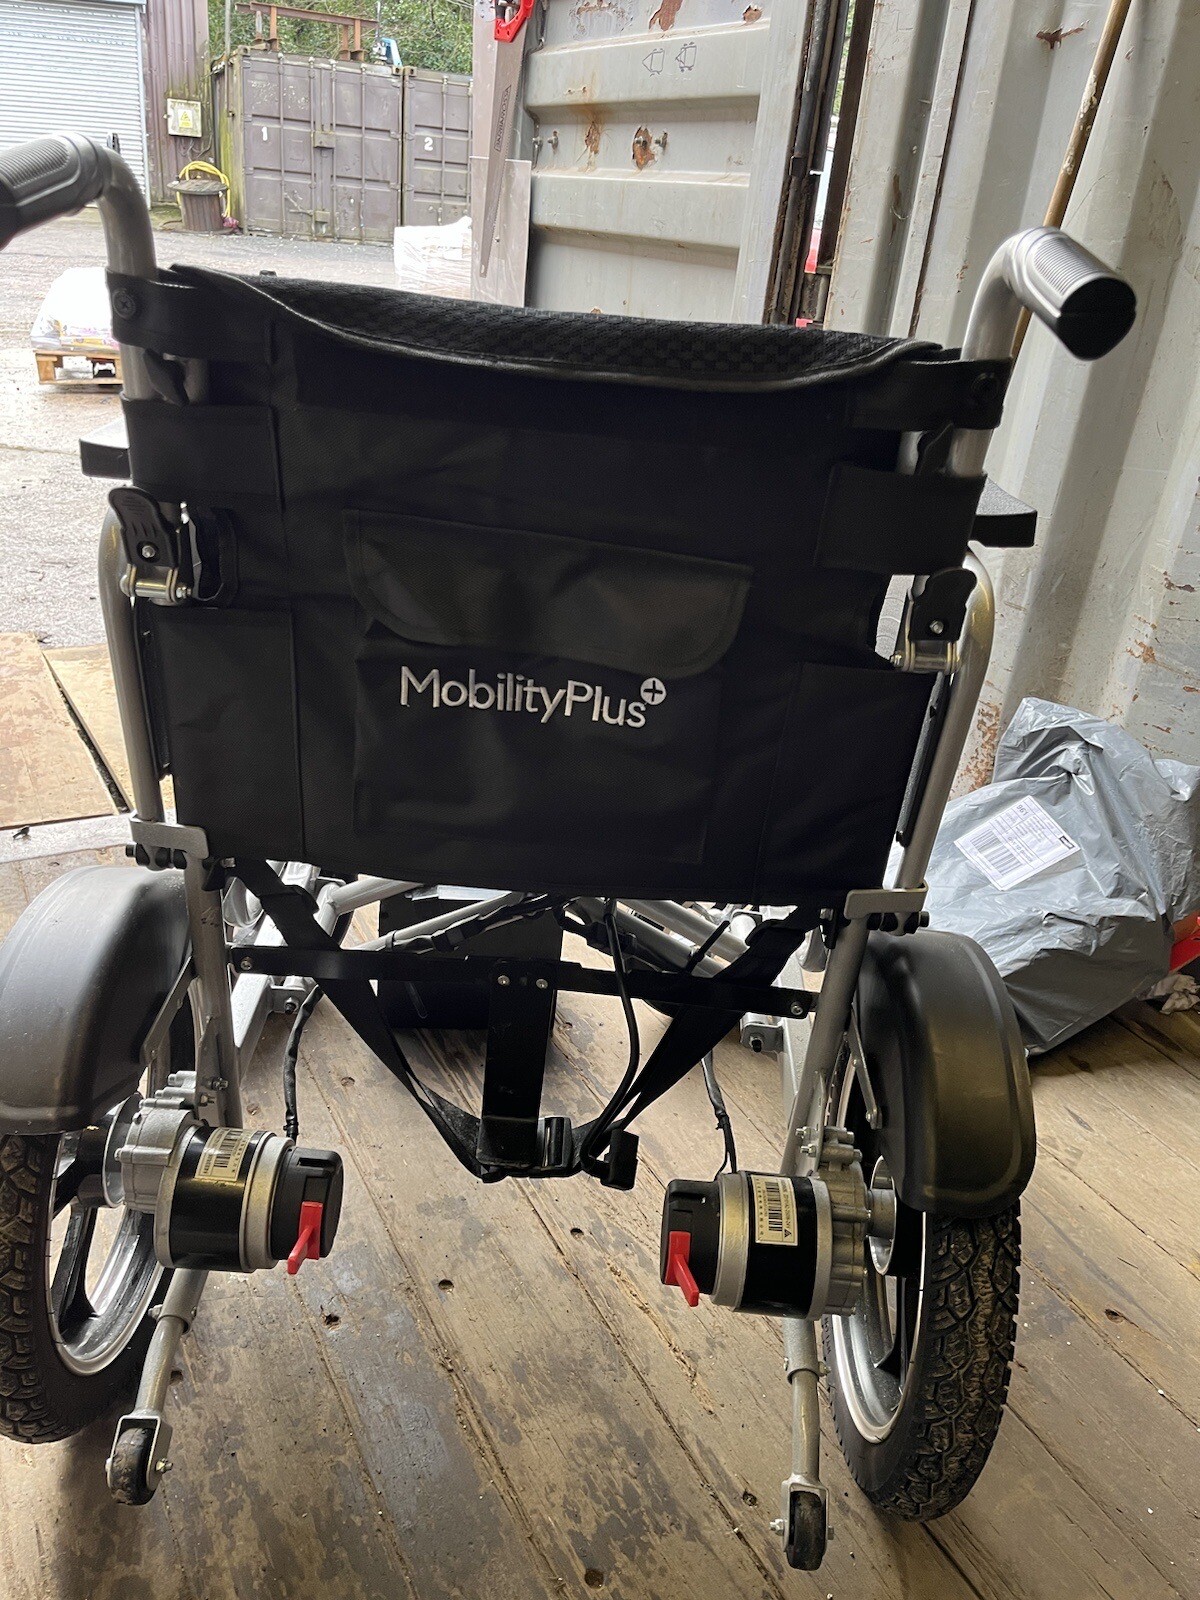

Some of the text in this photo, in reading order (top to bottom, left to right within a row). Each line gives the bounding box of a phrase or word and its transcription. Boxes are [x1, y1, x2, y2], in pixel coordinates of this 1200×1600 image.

[261, 126, 268, 141] 1
[424, 136, 434, 151] 2
[400, 665, 647, 728] MobilityPlus
